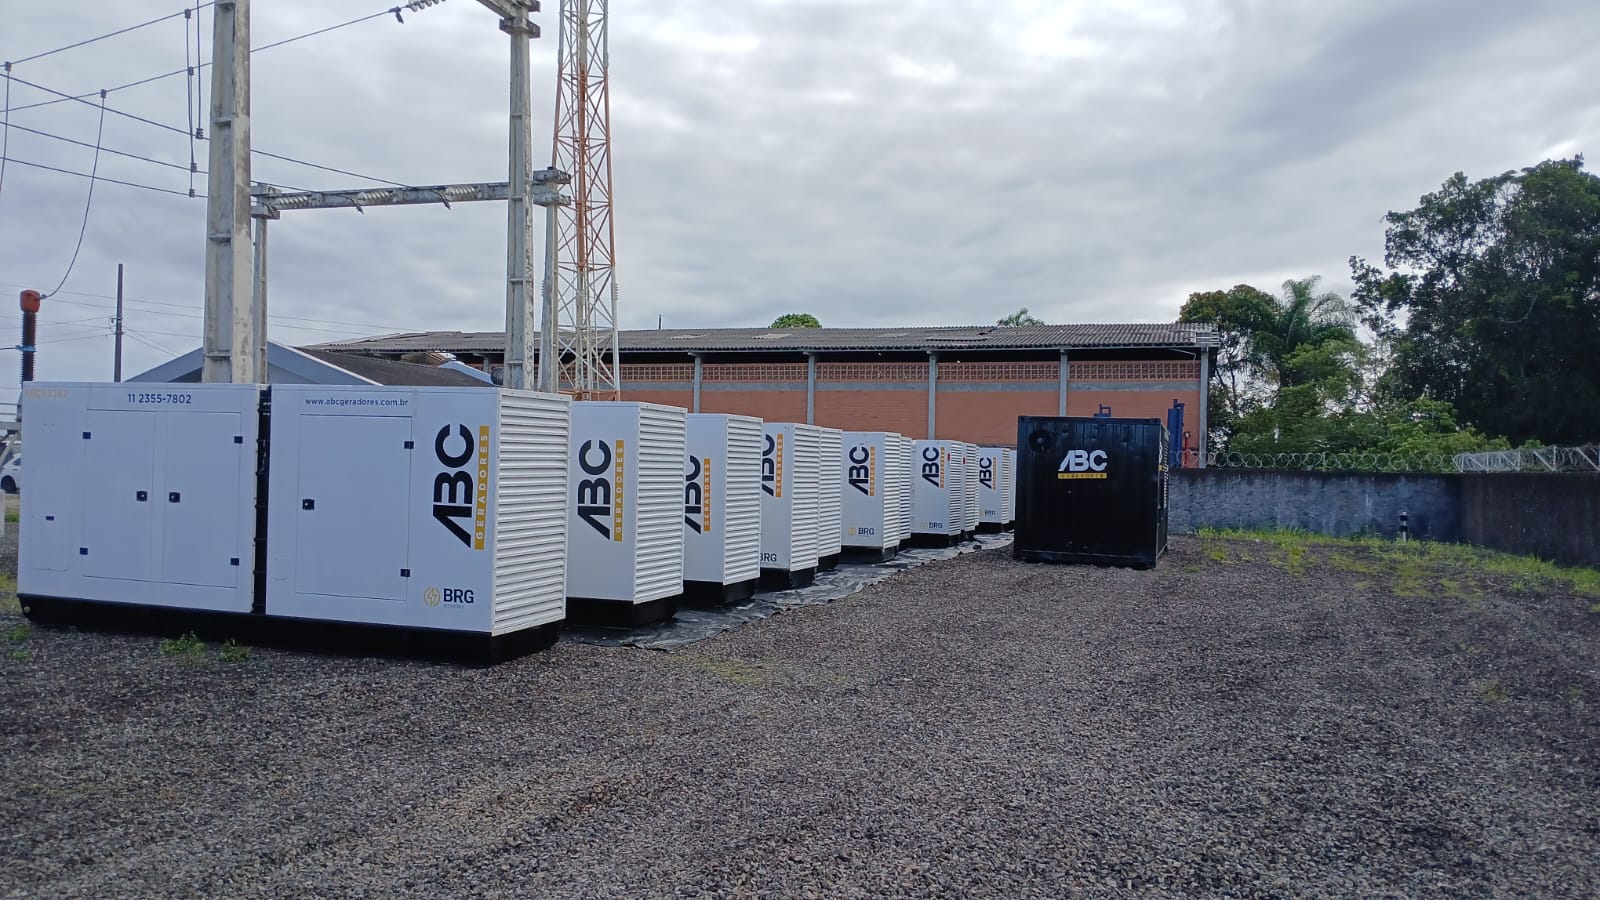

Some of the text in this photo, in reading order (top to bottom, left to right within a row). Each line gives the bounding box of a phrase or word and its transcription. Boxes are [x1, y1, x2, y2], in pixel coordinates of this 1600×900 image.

[127, 393, 192, 404] 11 2355-7802
[304, 398, 408, 406] www.abcgeradores.com.br
[848, 446, 870, 496] ABC
[922, 447, 940, 488] ABC
[980, 457, 992, 490] ABC
[1058, 450, 1108, 472] ABC
[432, 424, 474, 548] ABC
[476, 434, 488, 540] GERADORES
[578, 440, 612, 540] ABC
[615, 447, 624, 534] GERADORES
[444, 588, 474, 604] BRG
